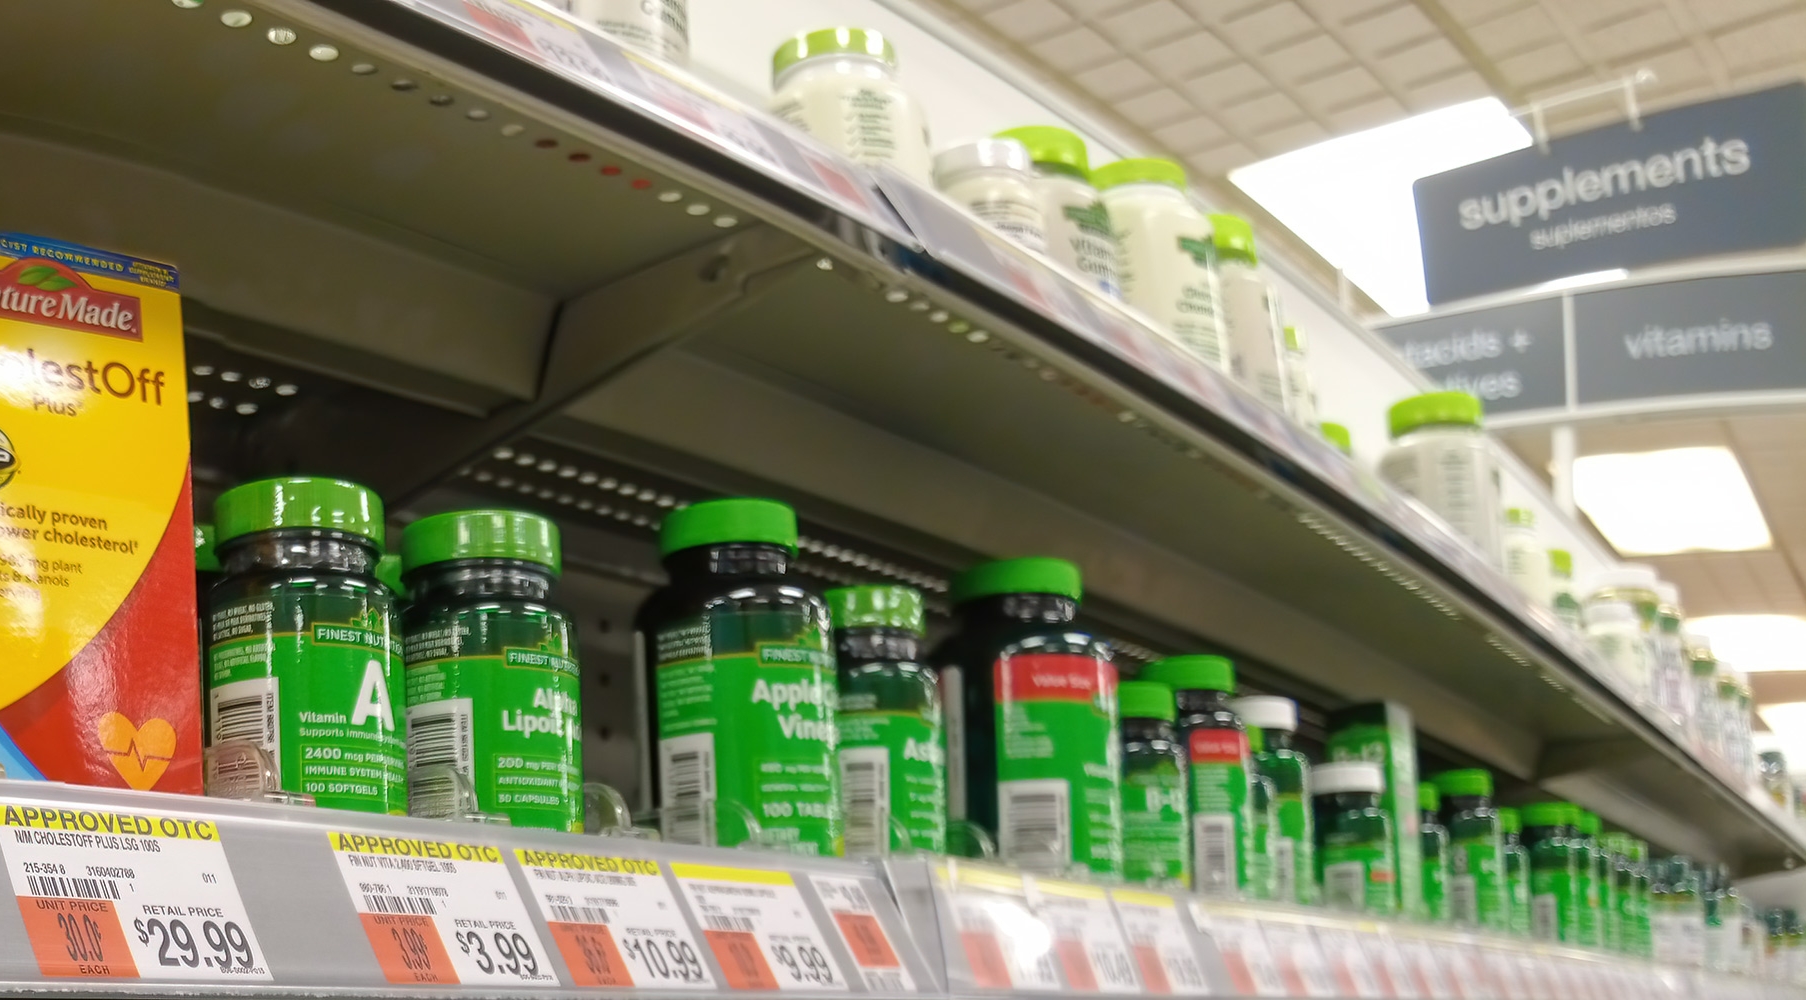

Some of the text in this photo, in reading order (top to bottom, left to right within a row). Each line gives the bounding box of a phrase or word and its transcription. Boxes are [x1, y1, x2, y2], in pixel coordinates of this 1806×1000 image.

[1458, 136, 1750, 230] supplements
[1530, 203, 1677, 250] suplementos
[1624, 319, 1773, 360] vitamins
[299, 660, 395, 731] Vitamin A
[337, 833, 499, 862] APPROVED OTC
[138, 919, 254, 969] $29.99
[455, 930, 538, 977] $3.99
[624, 937, 699, 983] $10.99
[772, 940, 833, 983] $9.99
